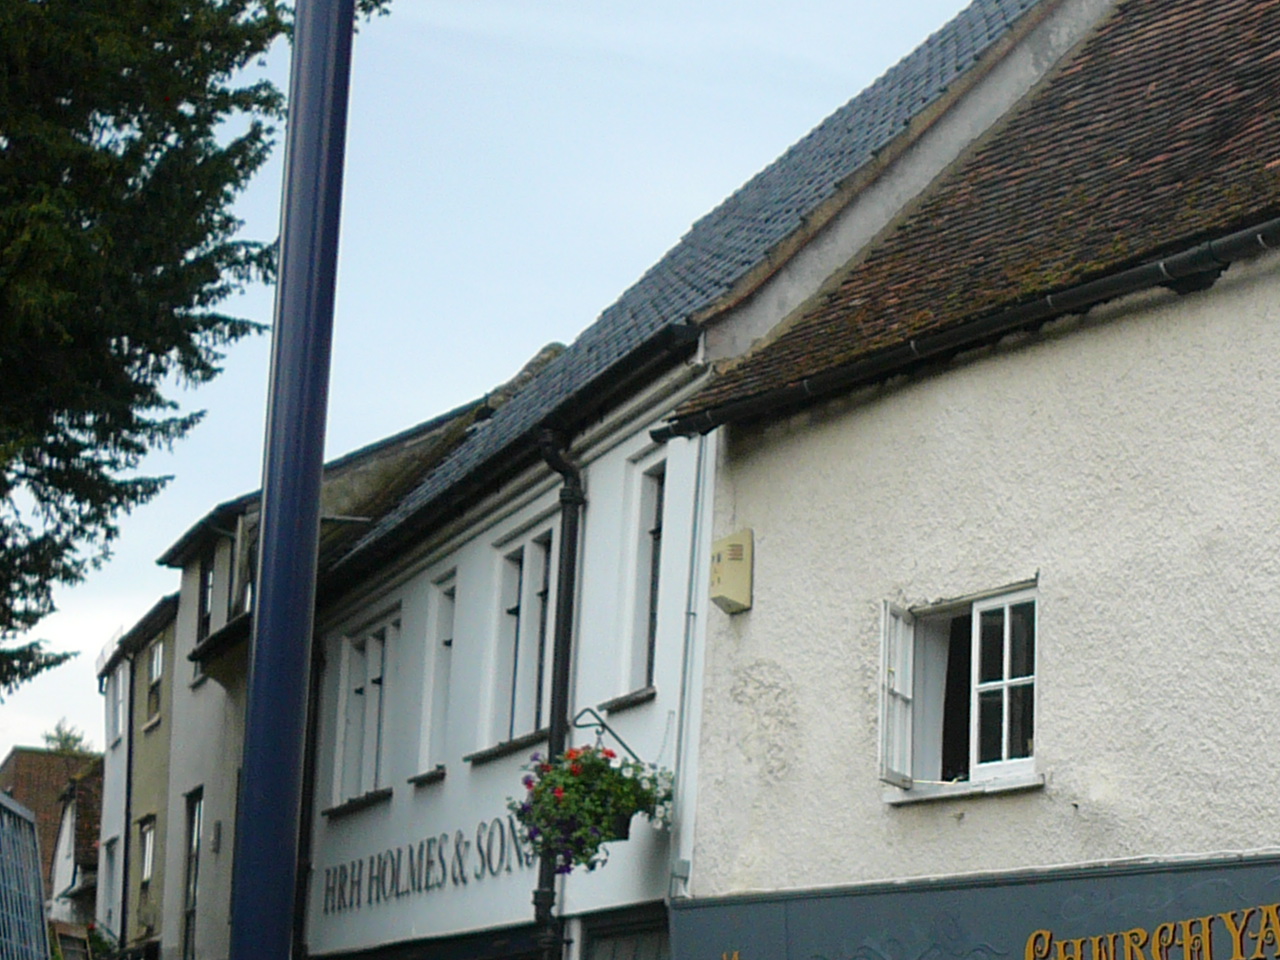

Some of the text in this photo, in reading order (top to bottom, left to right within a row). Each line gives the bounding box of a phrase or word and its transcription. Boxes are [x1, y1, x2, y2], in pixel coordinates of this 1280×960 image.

[323, 858, 363, 916] HRH
[367, 832, 449, 906] HOLMES
[452, 829, 471, 887] &
